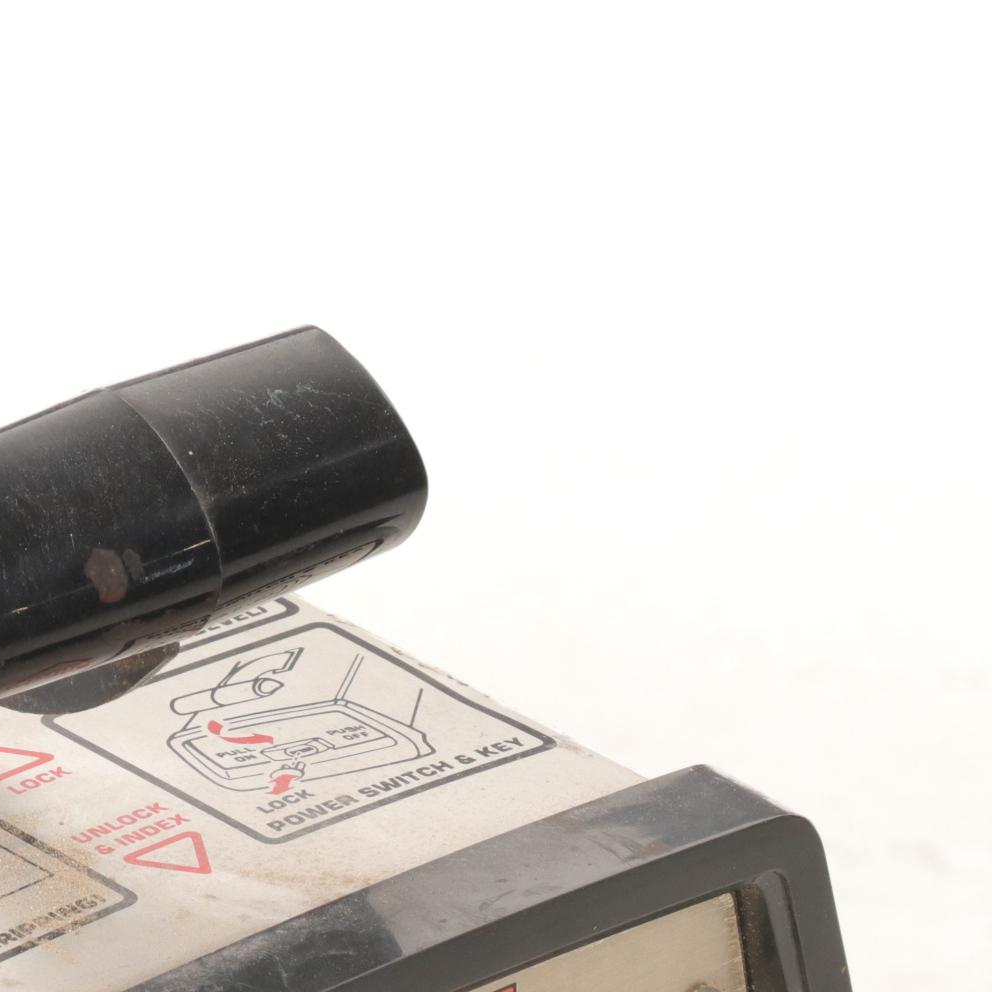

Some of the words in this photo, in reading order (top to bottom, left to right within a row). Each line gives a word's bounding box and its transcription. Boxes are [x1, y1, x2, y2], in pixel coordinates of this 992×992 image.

[216, 747, 257, 758] PULL
[8, 766, 72, 795] LOCK
[265, 795, 360, 832] POWER
[358, 760, 454, 799] SWITCH
[453, 753, 477, 766] &
[477, 737, 525, 760] KEY
[256, 789, 315, 814] LOCK
[70, 802, 169, 844] UNLOCK
[95, 841, 115, 855] &
[113, 813, 190, 847] INDEX
